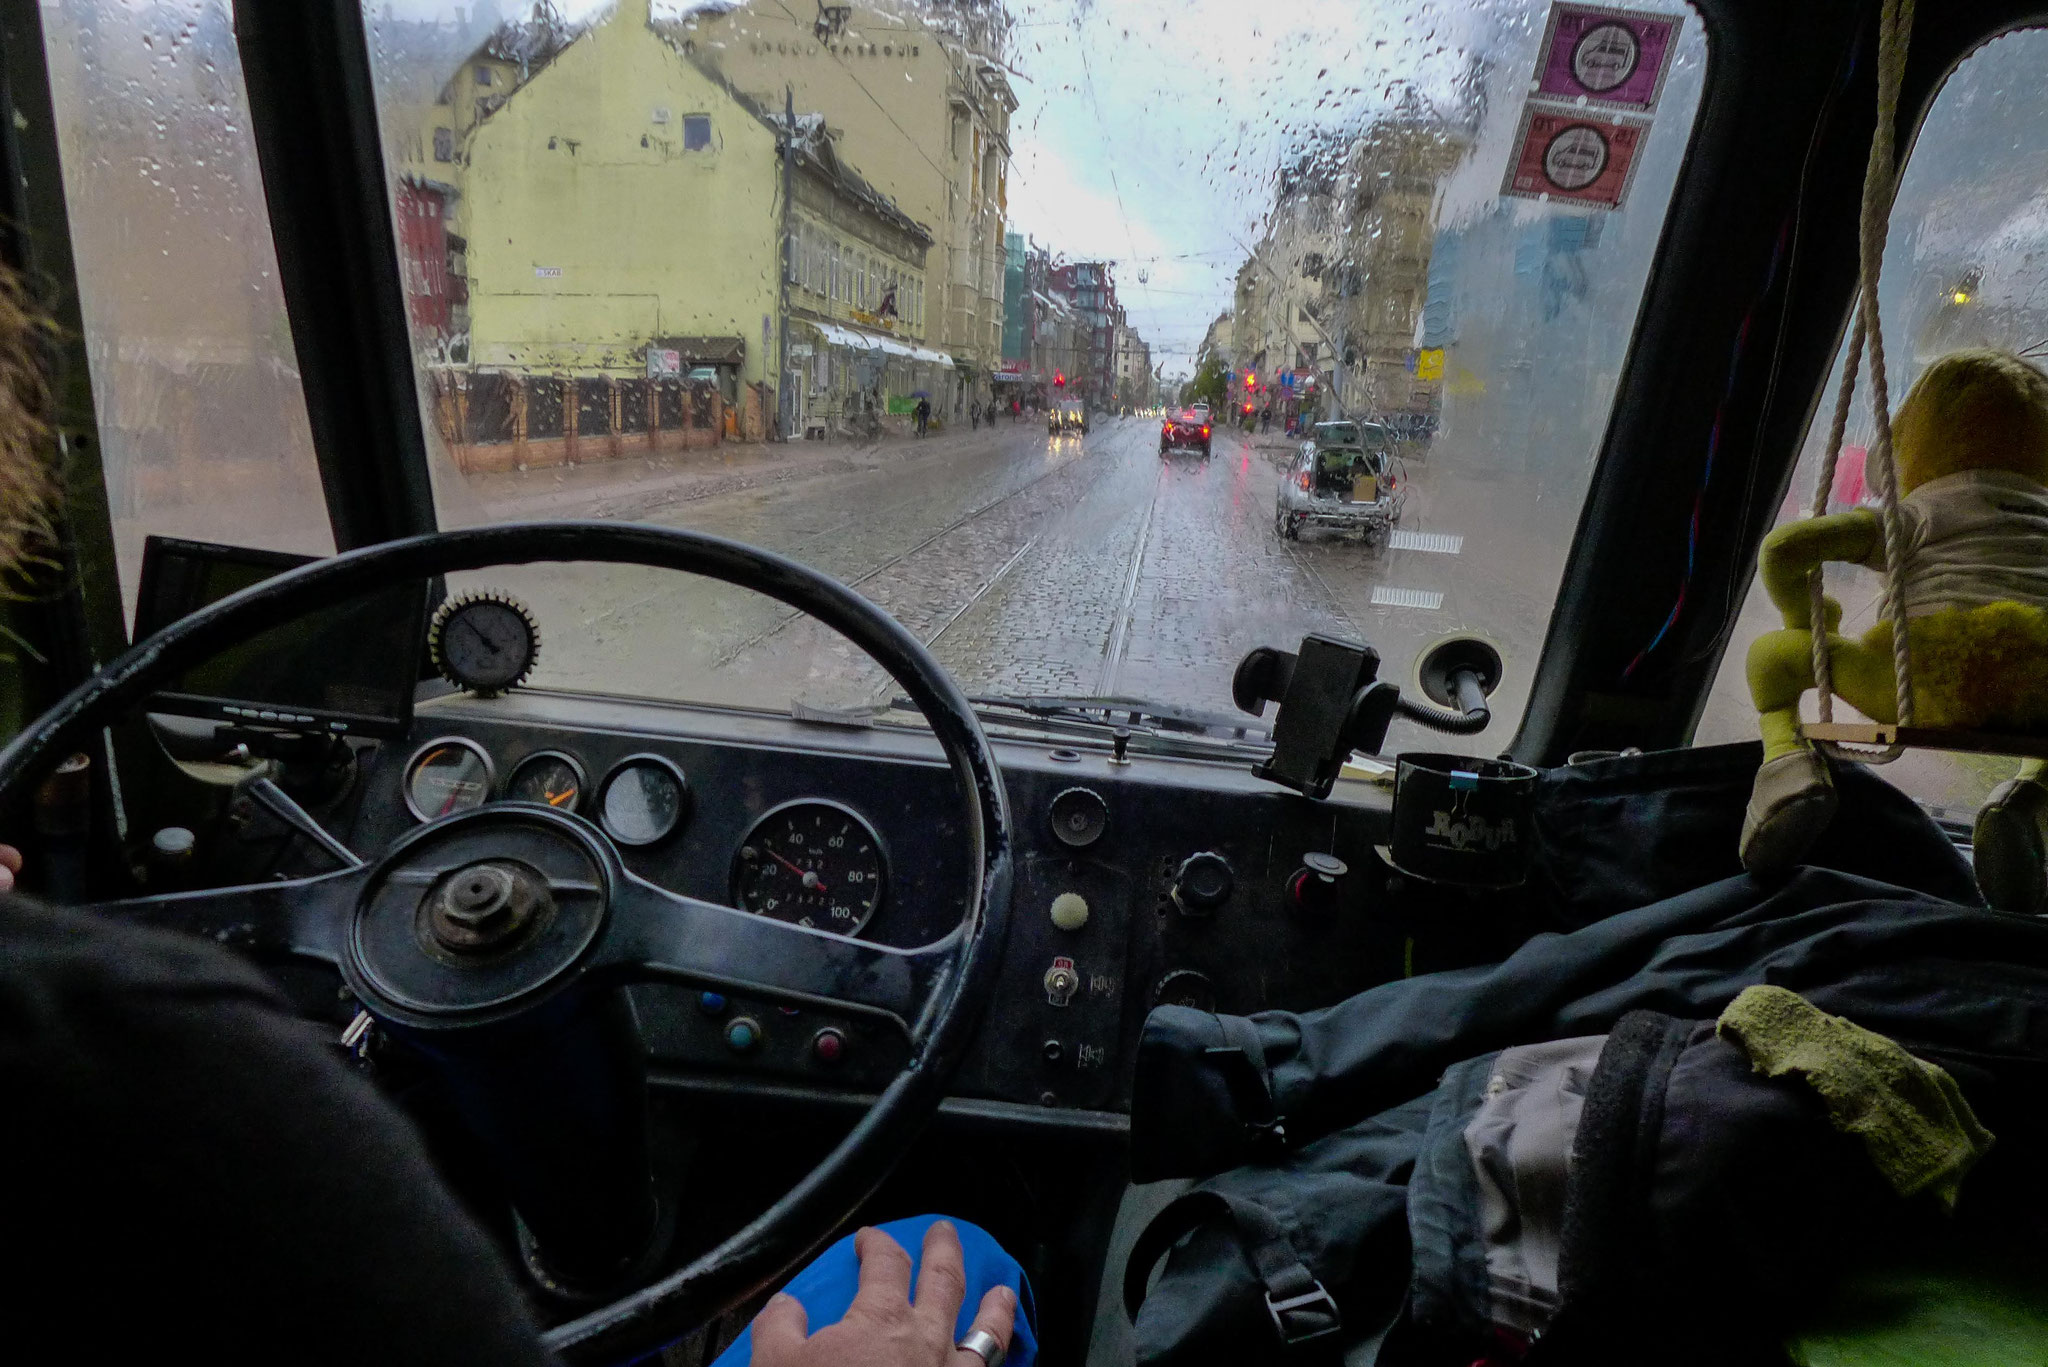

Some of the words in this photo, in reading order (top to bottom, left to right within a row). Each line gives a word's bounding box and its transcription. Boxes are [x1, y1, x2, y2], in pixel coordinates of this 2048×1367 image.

[788, 833, 803, 844] 40
[828, 837, 843, 847] 60
[762, 864, 777, 876] 20
[848, 872, 862, 882] 80
[830, 907, 850, 918] 100
